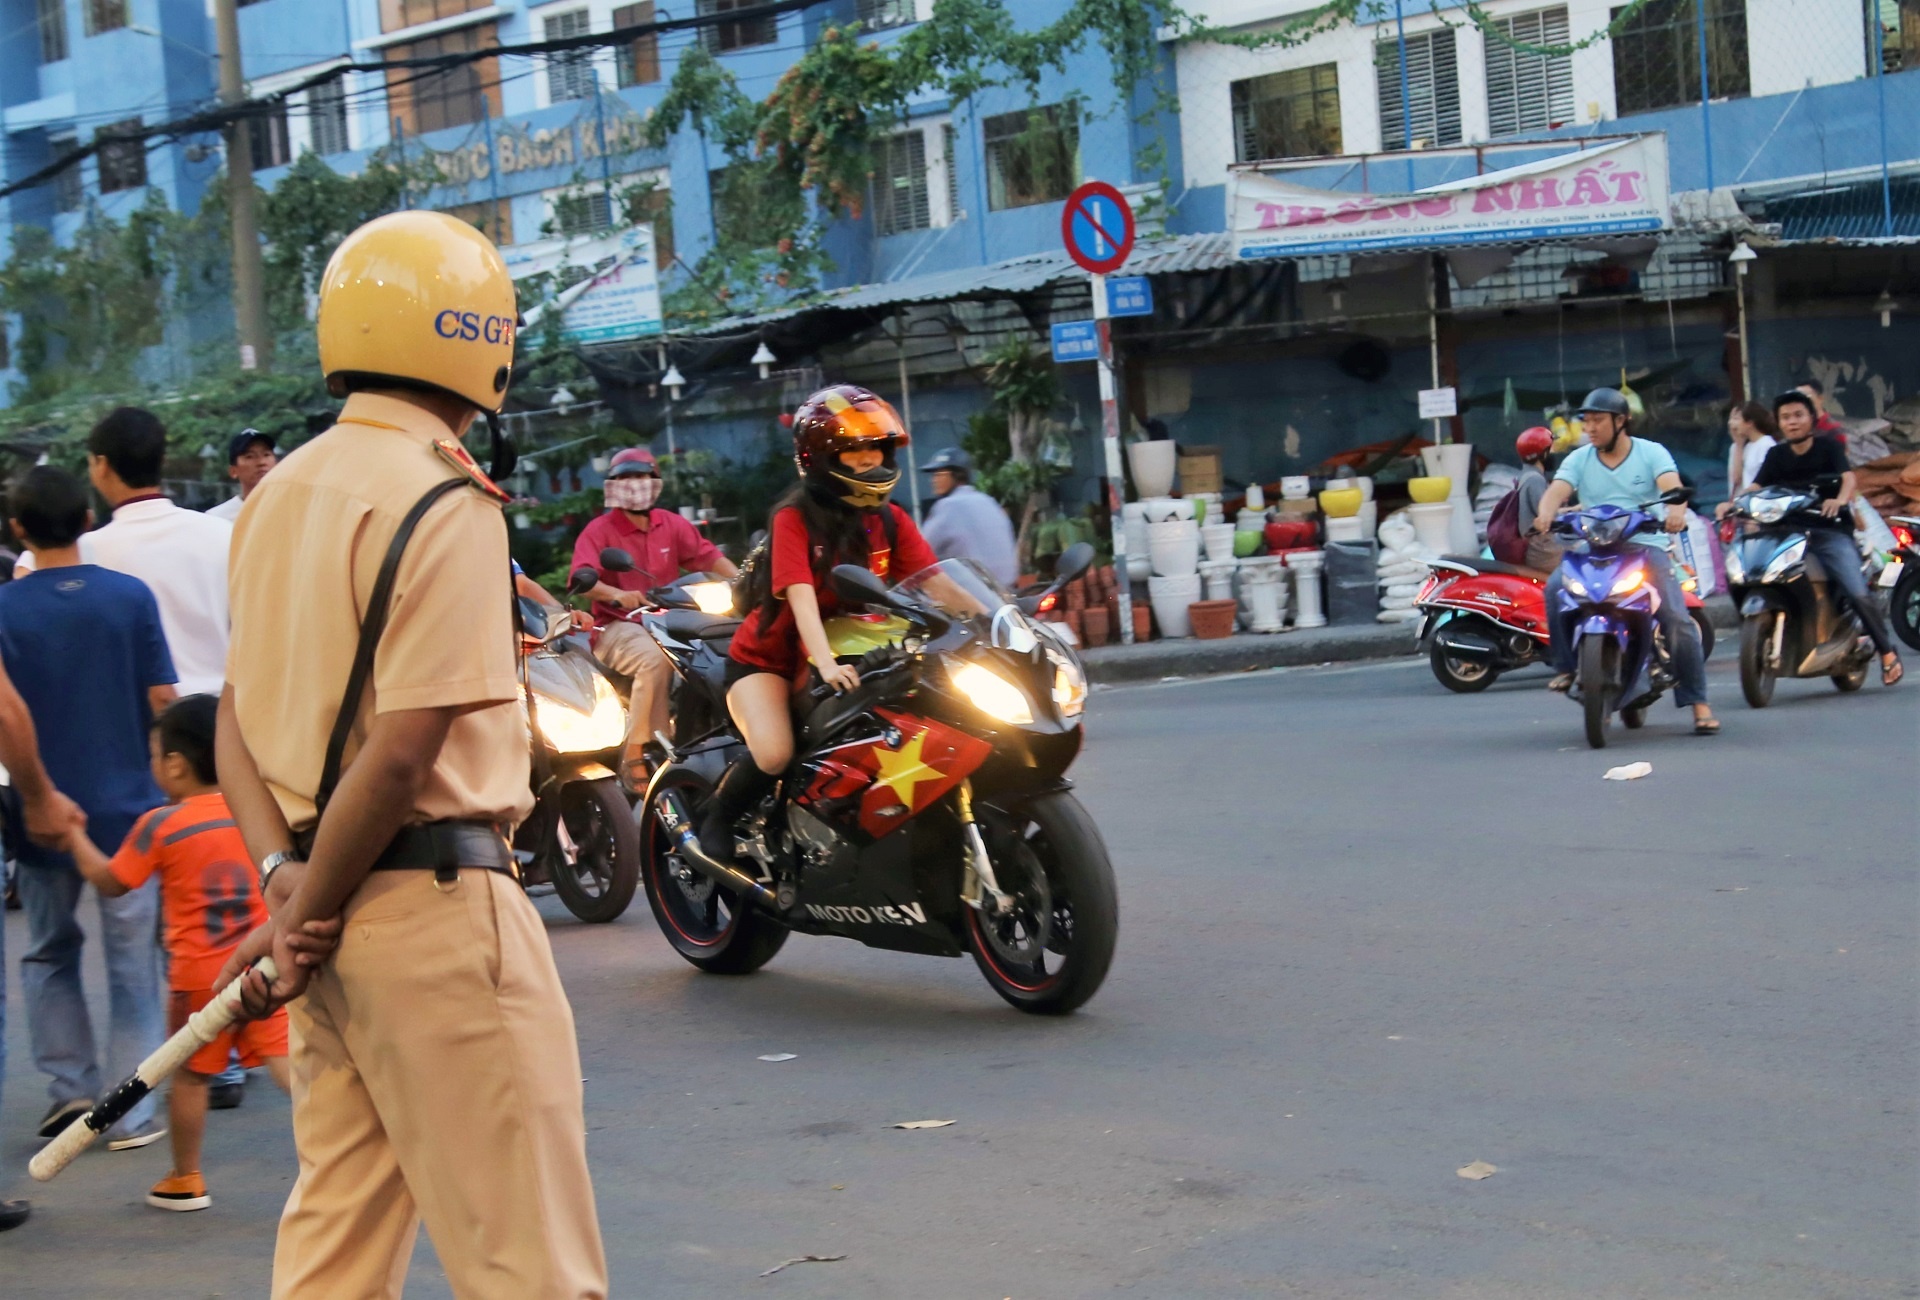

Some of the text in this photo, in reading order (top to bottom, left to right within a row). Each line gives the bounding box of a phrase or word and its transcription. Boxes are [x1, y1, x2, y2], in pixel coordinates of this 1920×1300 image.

[1472, 161, 1641, 213] NHẤT
[434, 309, 513, 345] CSGT
[202, 860, 251, 946] 8
[805, 903, 872, 924] MOTO
